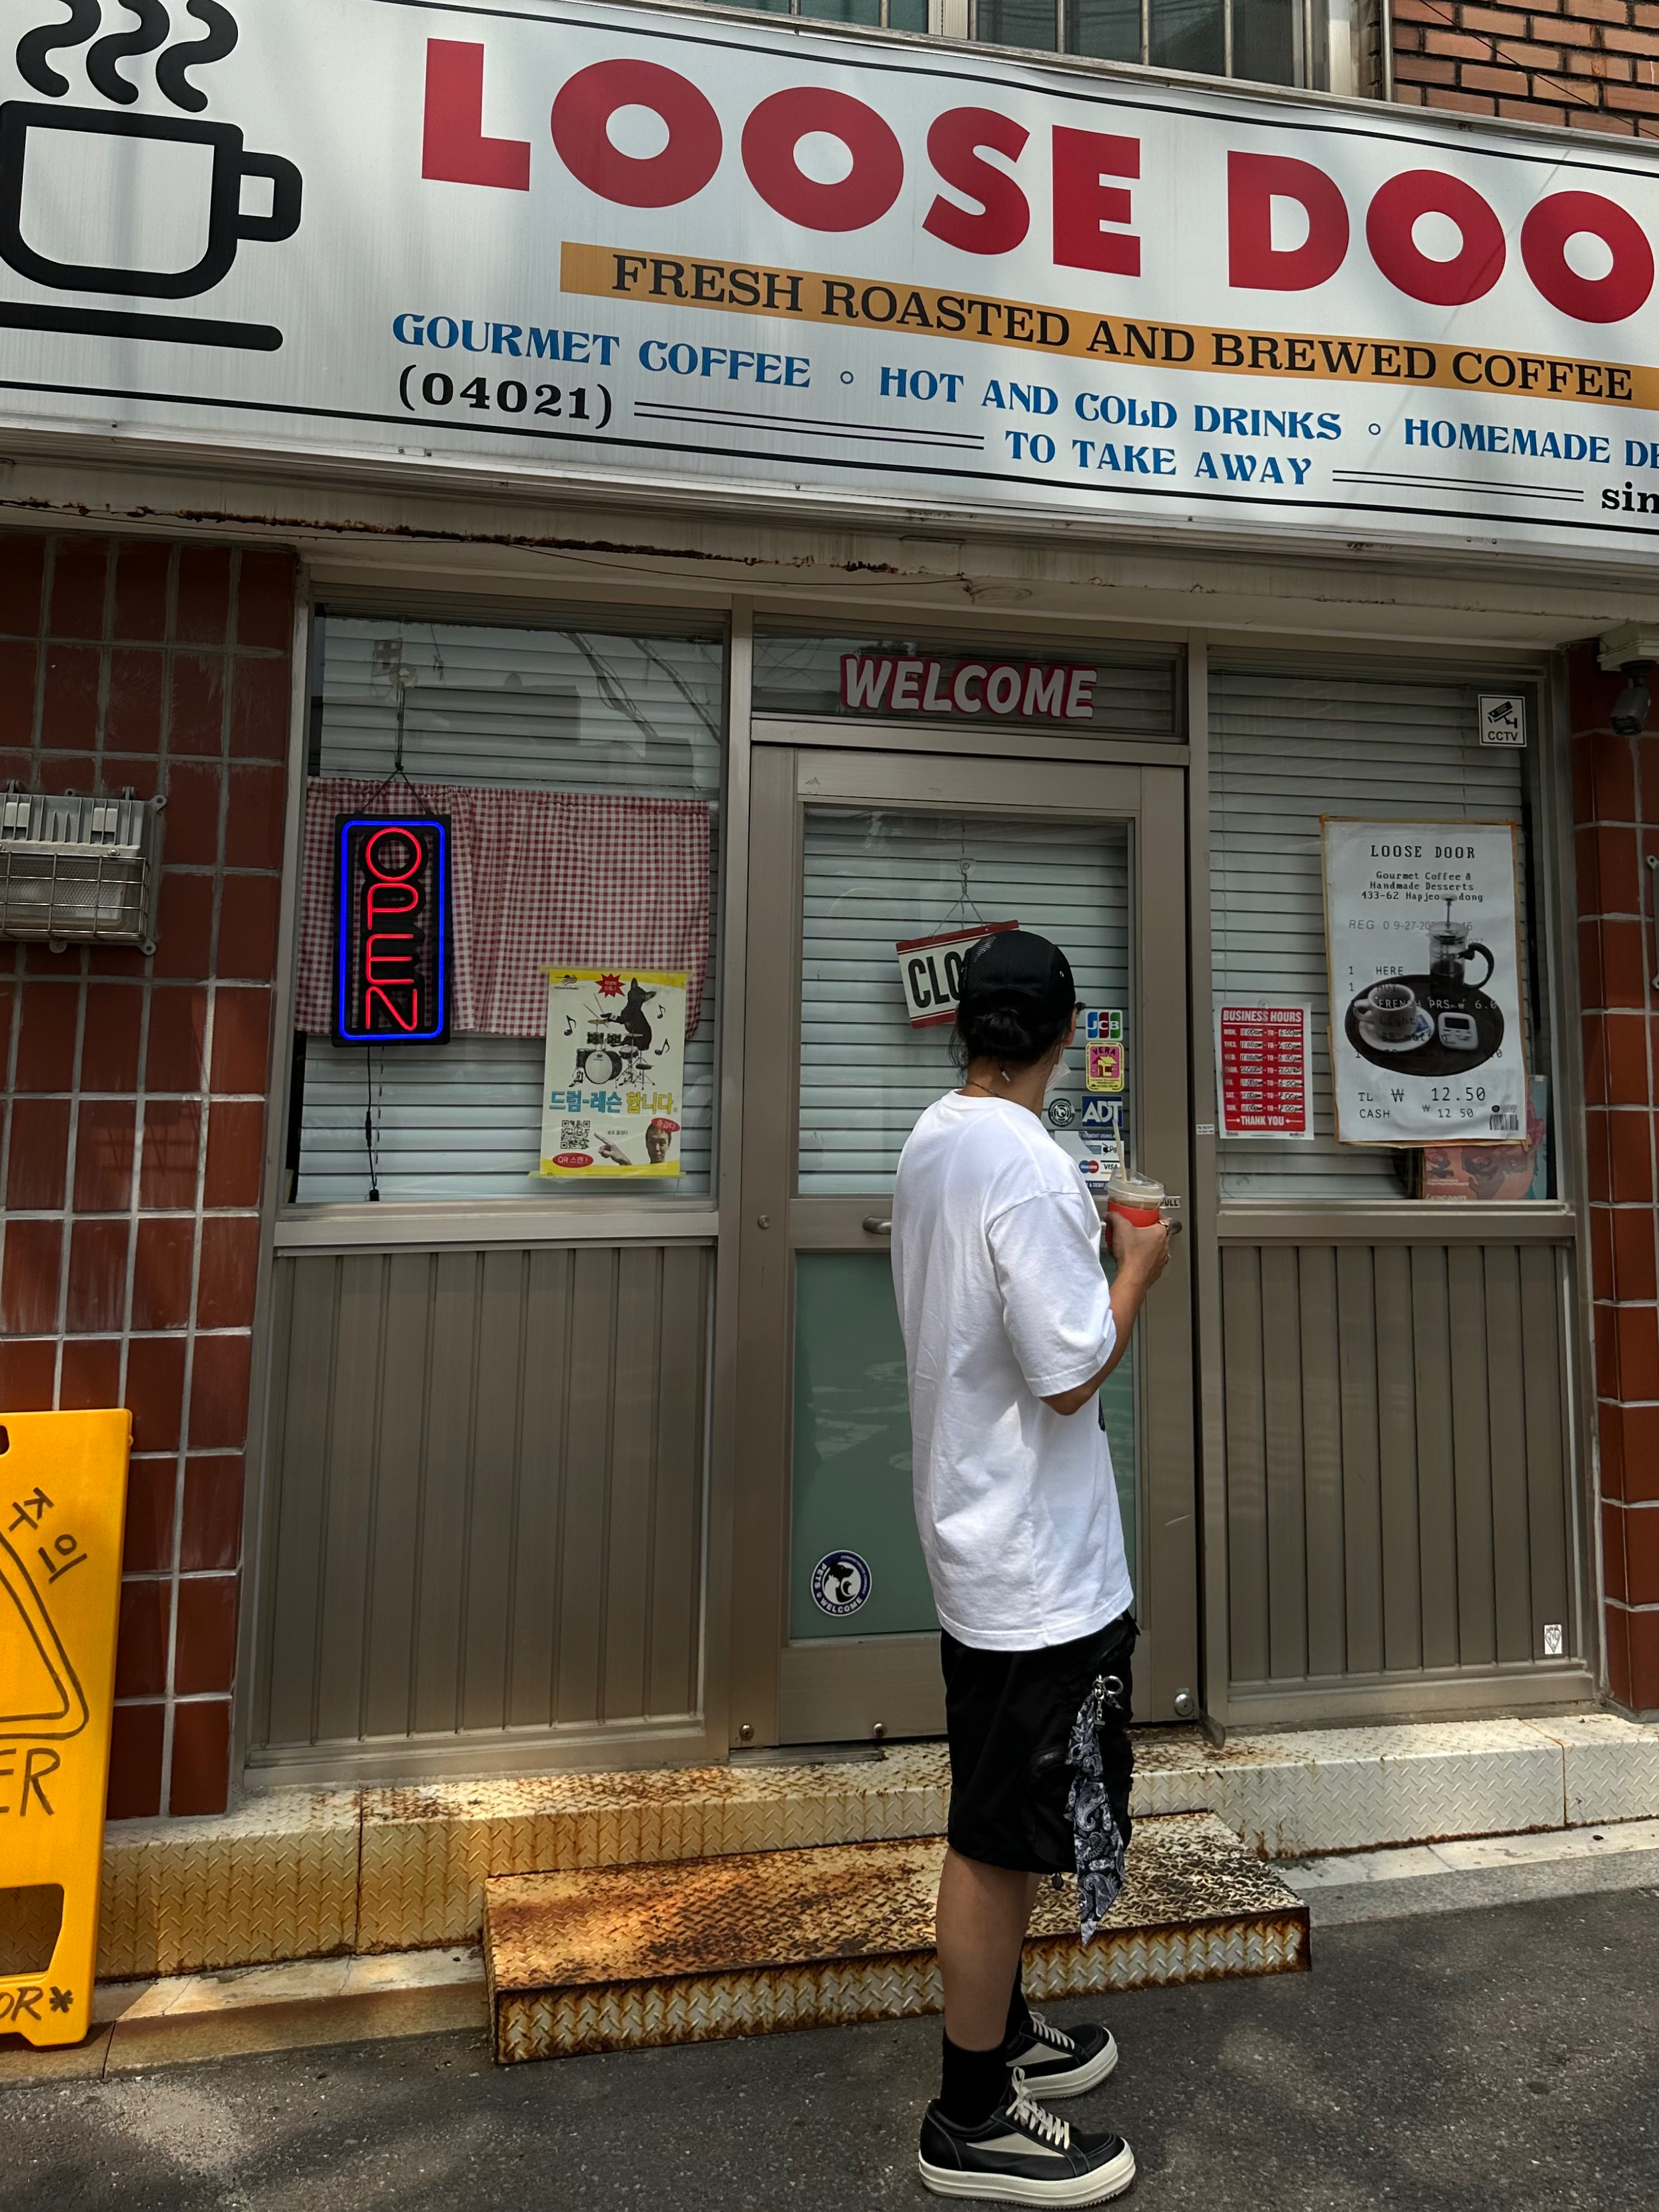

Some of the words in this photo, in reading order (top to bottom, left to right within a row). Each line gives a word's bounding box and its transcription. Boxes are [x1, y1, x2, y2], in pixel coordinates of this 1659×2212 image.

[423, 39, 1141, 276] LOOSE
[1228, 152, 1655, 323] DOO
[611, 255, 803, 312] FRESH
[821, 280, 1070, 346] ROASTED
[1087, 321, 1194, 362] AND
[1212, 333, 1436, 379] BREWED
[1452, 351, 1632, 401] COFFEE
[393, 314, 619, 366] GOURMET
[639, 341, 811, 389] COFFEE
[880, 367, 965, 403] HOT
[982, 379, 1060, 415] AND
[1075, 393, 1178, 429] COLD
[1194, 405, 1342, 441] DRINKS
[1405, 418, 1610, 463] HOMEMADE
[399, 364, 612, 429] (04021)
[1005, 430, 1056, 463] TO
[1072, 439, 1177, 475] TAKE
[1196, 451, 1312, 485] AWAY
[841, 654, 1098, 719] WELCOME
[1488, 730, 1518, 742] CCTV
[1370, 844, 1422, 858] LOOSE
[1434, 846, 1475, 859] DOOR
[1376, 871, 1419, 880] Gourmet
[1425, 872, 1462, 881] Coffee
[1465, 873, 1471, 881] &
[1370, 881, 1420, 890] Handmade
[1425, 882, 1474, 891] Desserts
[365, 827, 422, 1031] OPEN
[1348, 920, 1375, 930] REG
[1348, 966, 1354, 975] 1
[1376, 966, 1404, 976] HERE
[908, 951, 962, 1008] CLO
[1349, 983, 1355, 992] 1
[1376, 983, 1398, 992] HOT
[1428, 999, 1450, 1009] PRS
[1222, 1010, 1269, 1022] BUSINESS
[1270, 1011, 1302, 1023] HOURS
[1087, 1020, 1120, 1031] JCB
[1092, 1046, 1116, 1056] VERA
[549, 1090, 623, 1113] 드럼-레슨
[1358, 1092, 1374, 1102] TL
[1431, 1086, 1486, 1102] 12.50
[1082, 1100, 1123, 1123] ADT
[1359, 1108, 1390, 1118] CASH
[1240, 1116, 1266, 1126] THANK
[1267, 1116, 1284, 1126] YOU
[557, 1156, 569, 1164] QR
[814, 1562, 827, 1589] PETS
[820, 1597, 863, 1614] WELCOME
